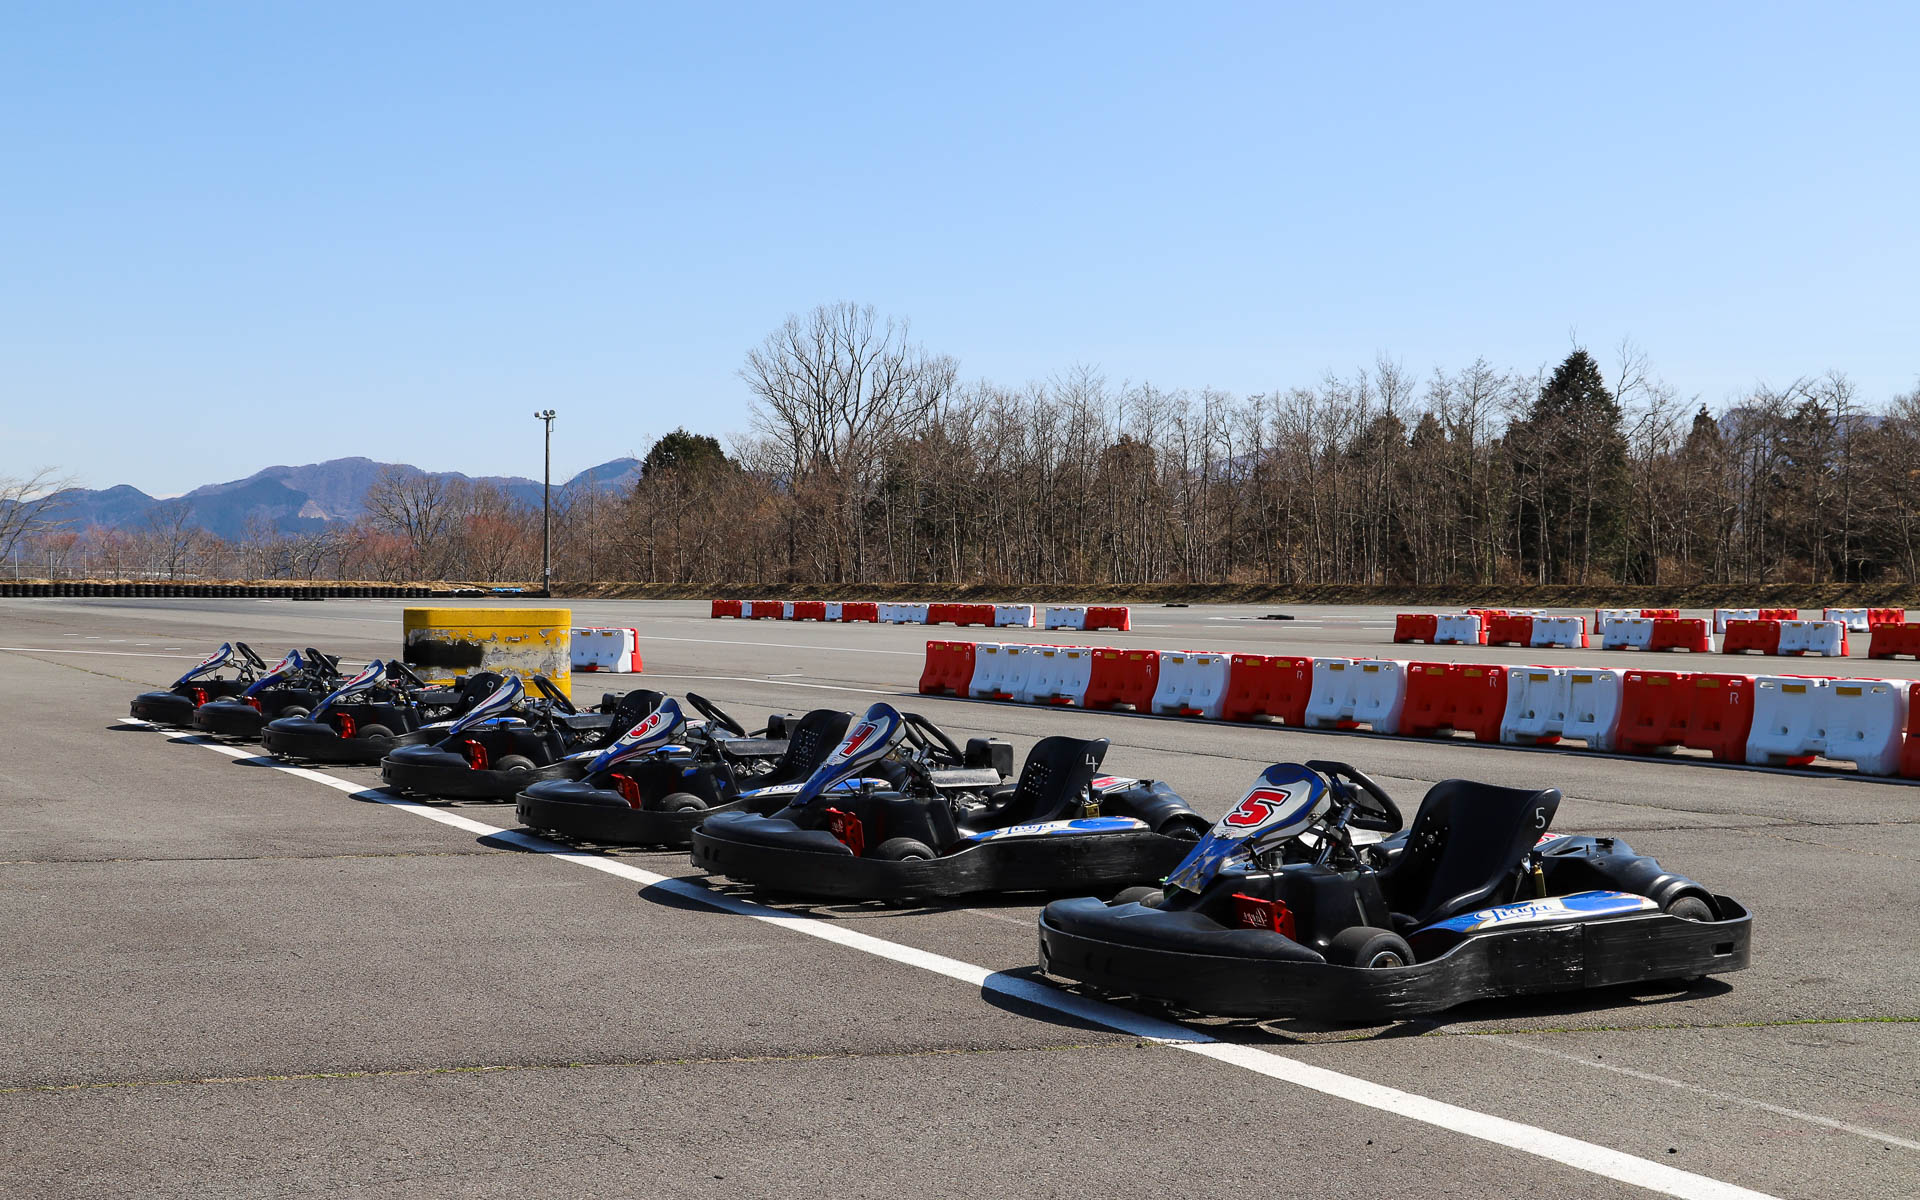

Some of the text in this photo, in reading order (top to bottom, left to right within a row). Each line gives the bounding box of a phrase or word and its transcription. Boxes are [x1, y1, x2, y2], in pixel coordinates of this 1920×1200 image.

[1296, 670, 1303, 681] R
[1489, 676, 1497, 688] R
[1729, 692, 1739, 705] R
[840, 722, 878, 758] 4
[1085, 753, 1099, 773] 4
[1224, 788, 1291, 828] 5
[1535, 807, 1546, 829] 5
